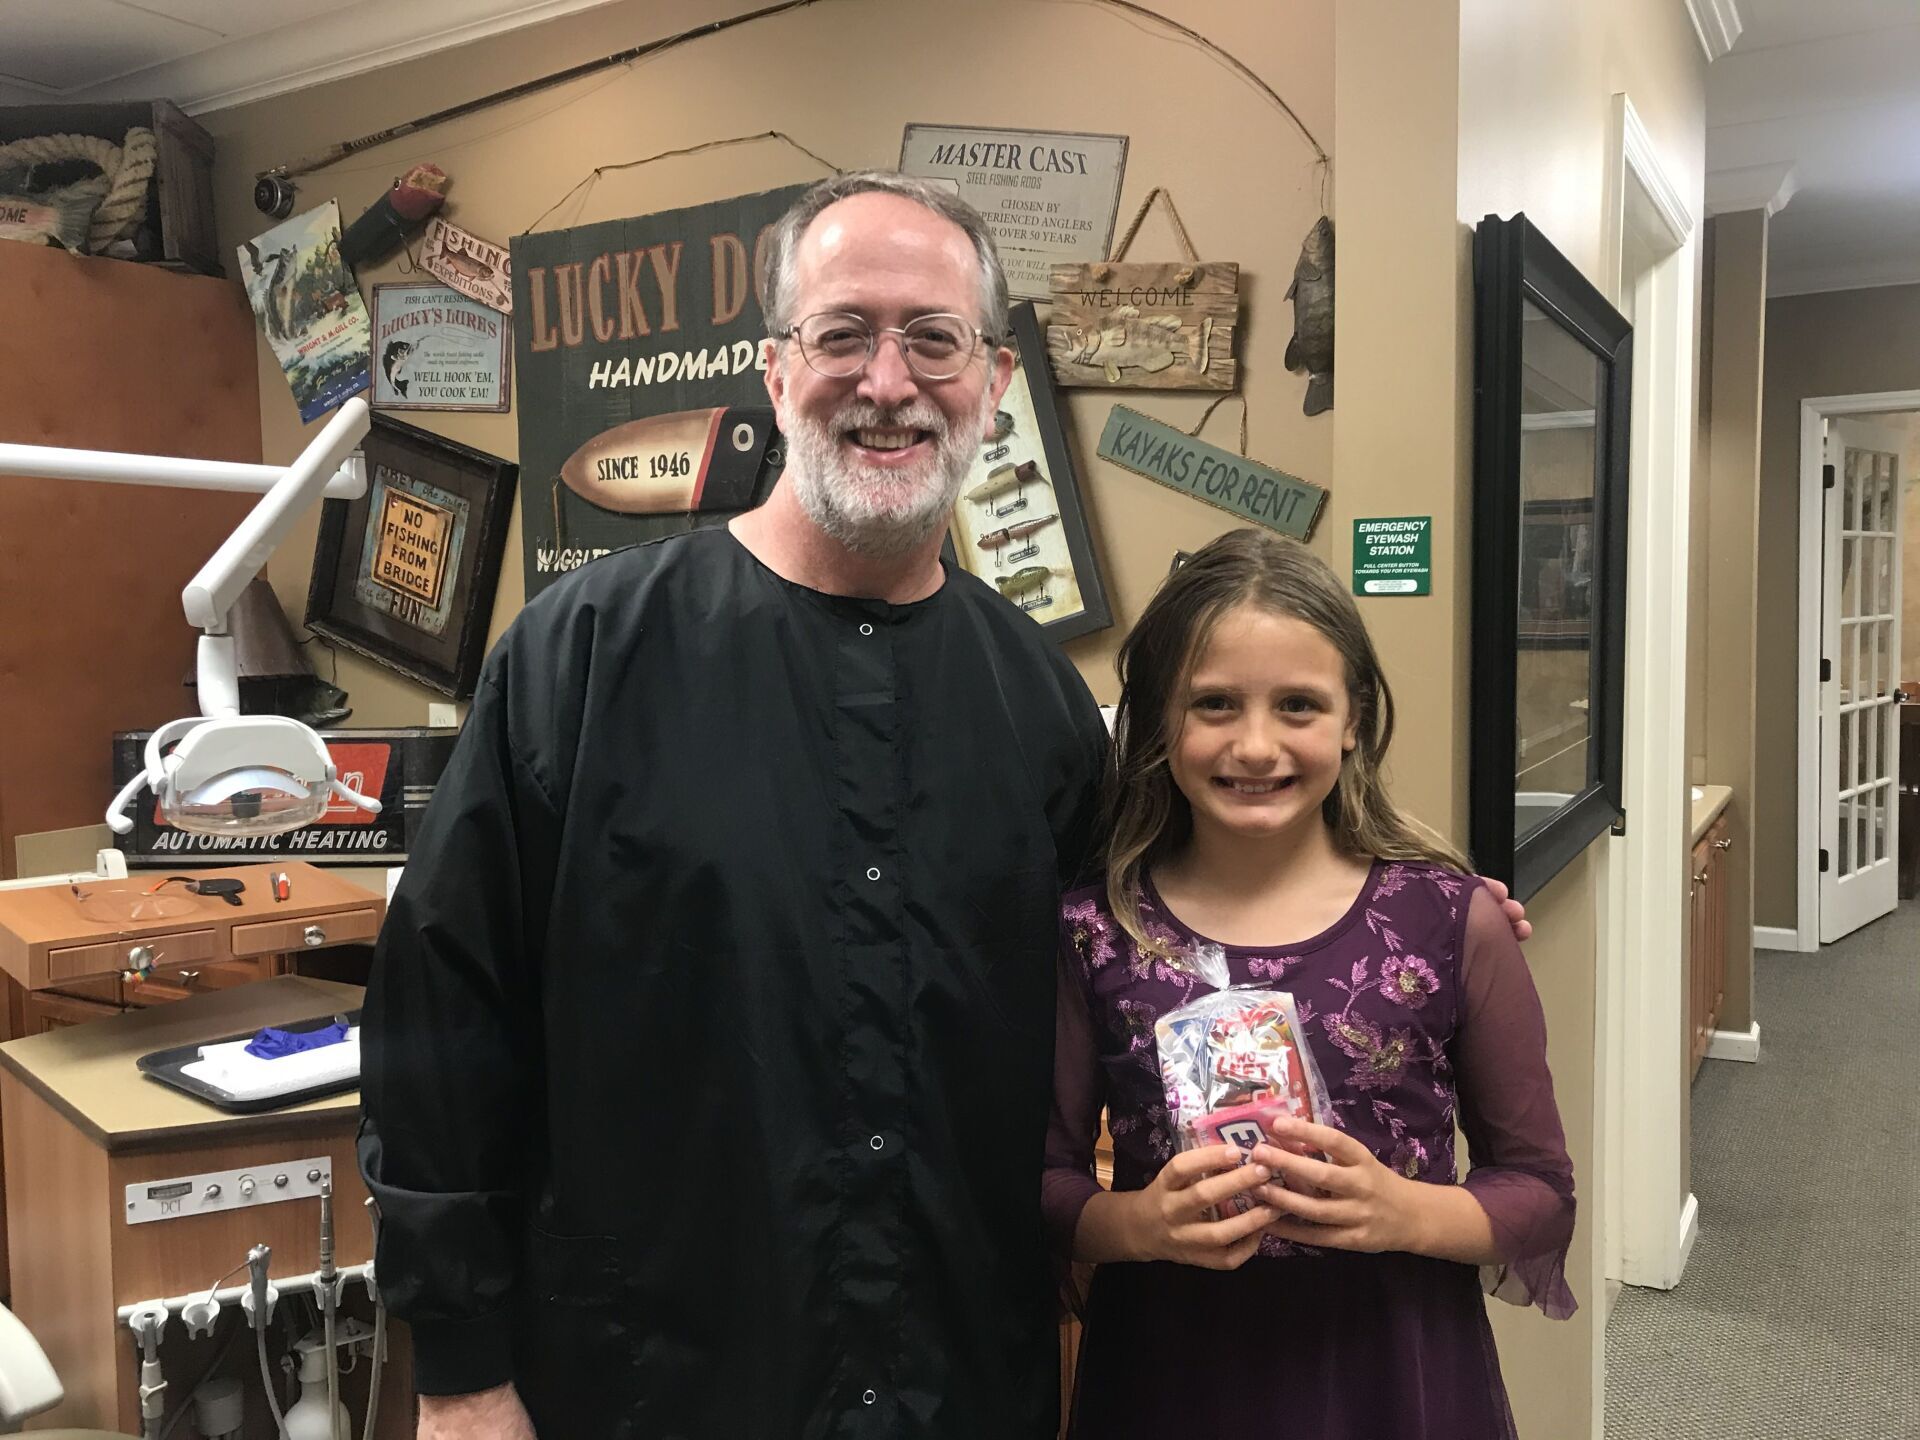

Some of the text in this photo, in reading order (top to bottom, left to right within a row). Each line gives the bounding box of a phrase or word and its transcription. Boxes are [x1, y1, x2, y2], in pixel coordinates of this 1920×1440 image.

[929, 142, 1089, 175] MASTER CAST
[966, 171, 1042, 190] STEEL FISHING RODS
[161, 200, 181, 215] DCI
[1001, 198, 1061, 214] CHOSEN BY
[980, 211, 1093, 232] PERIENCED ANGLERS
[999, 227, 1027, 240] OVER
[1029, 230, 1040, 240] 50
[1042, 231, 1077, 245] YEARS
[433, 261, 494, 301] EXPEDITIONS
[404, 294, 421, 305] FISH
[528, 241, 684, 352] LUCKY
[1080, 286, 1195, 308] WELCOME
[382, 307, 497, 340] LUCKY'S LURES
[297, 337, 322, 355] WRIGHT
[413, 371, 441, 383] WE'LL
[443, 371, 472, 383] HOOK
[418, 387, 438, 398] YOU
[440, 387, 466, 398] COOK
[597, 451, 691, 482] SINCE 1946
[1110, 423, 1306, 524] KAYAKS FOR RENT
[403, 508, 423, 528] NO
[1358, 521, 1427, 533] EMERGENCY
[386, 522, 438, 555] FISHING
[1365, 533, 1419, 544] EYEWASH
[391, 544, 427, 571] FROM
[537, 548, 611, 573] WIGGL
[1369, 545, 1415, 556] STATION
[384, 560, 430, 593] BRIDGE
[389, 590, 424, 625] FUN
[152, 829, 388, 851] AUTOMATIC HEATING
